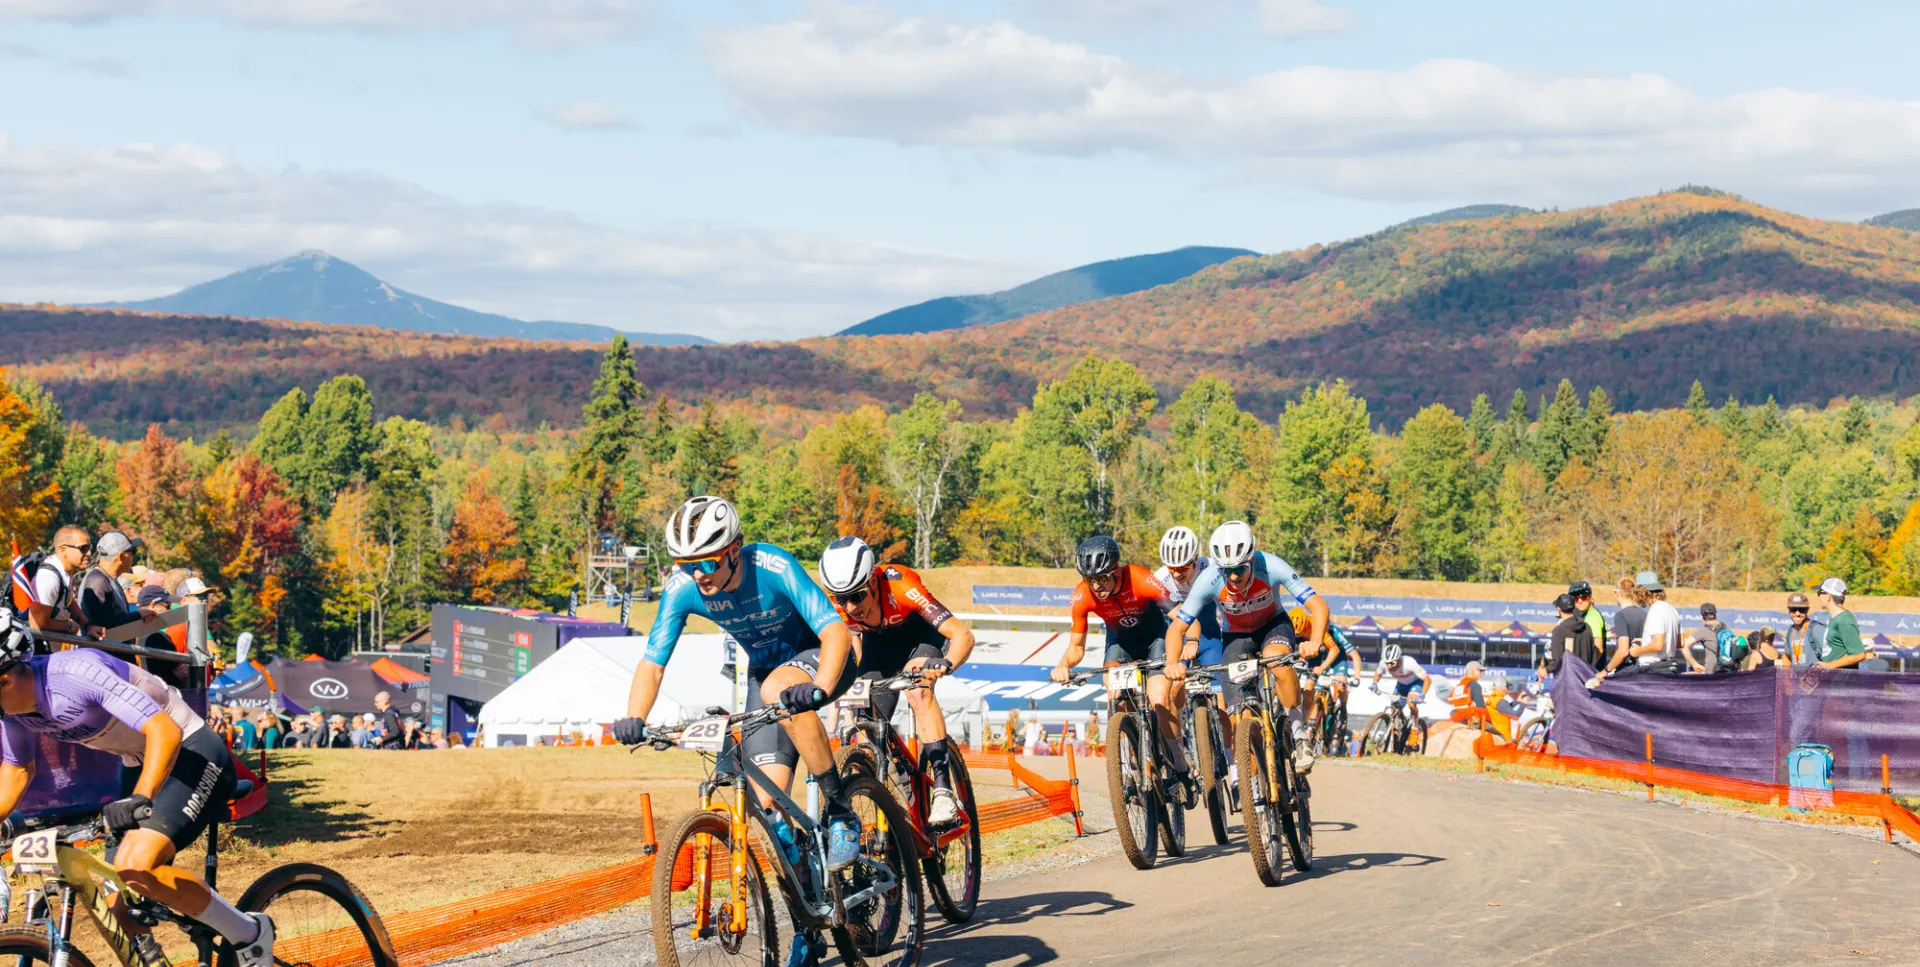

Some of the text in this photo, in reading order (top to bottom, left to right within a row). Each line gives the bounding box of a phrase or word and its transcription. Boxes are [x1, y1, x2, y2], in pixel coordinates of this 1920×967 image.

[904, 587, 938, 614] BMC
[932, 610, 950, 626] BOSS
[1237, 663, 1248, 672] 6
[687, 723, 720, 738] 28
[20, 836, 49, 858] 23
